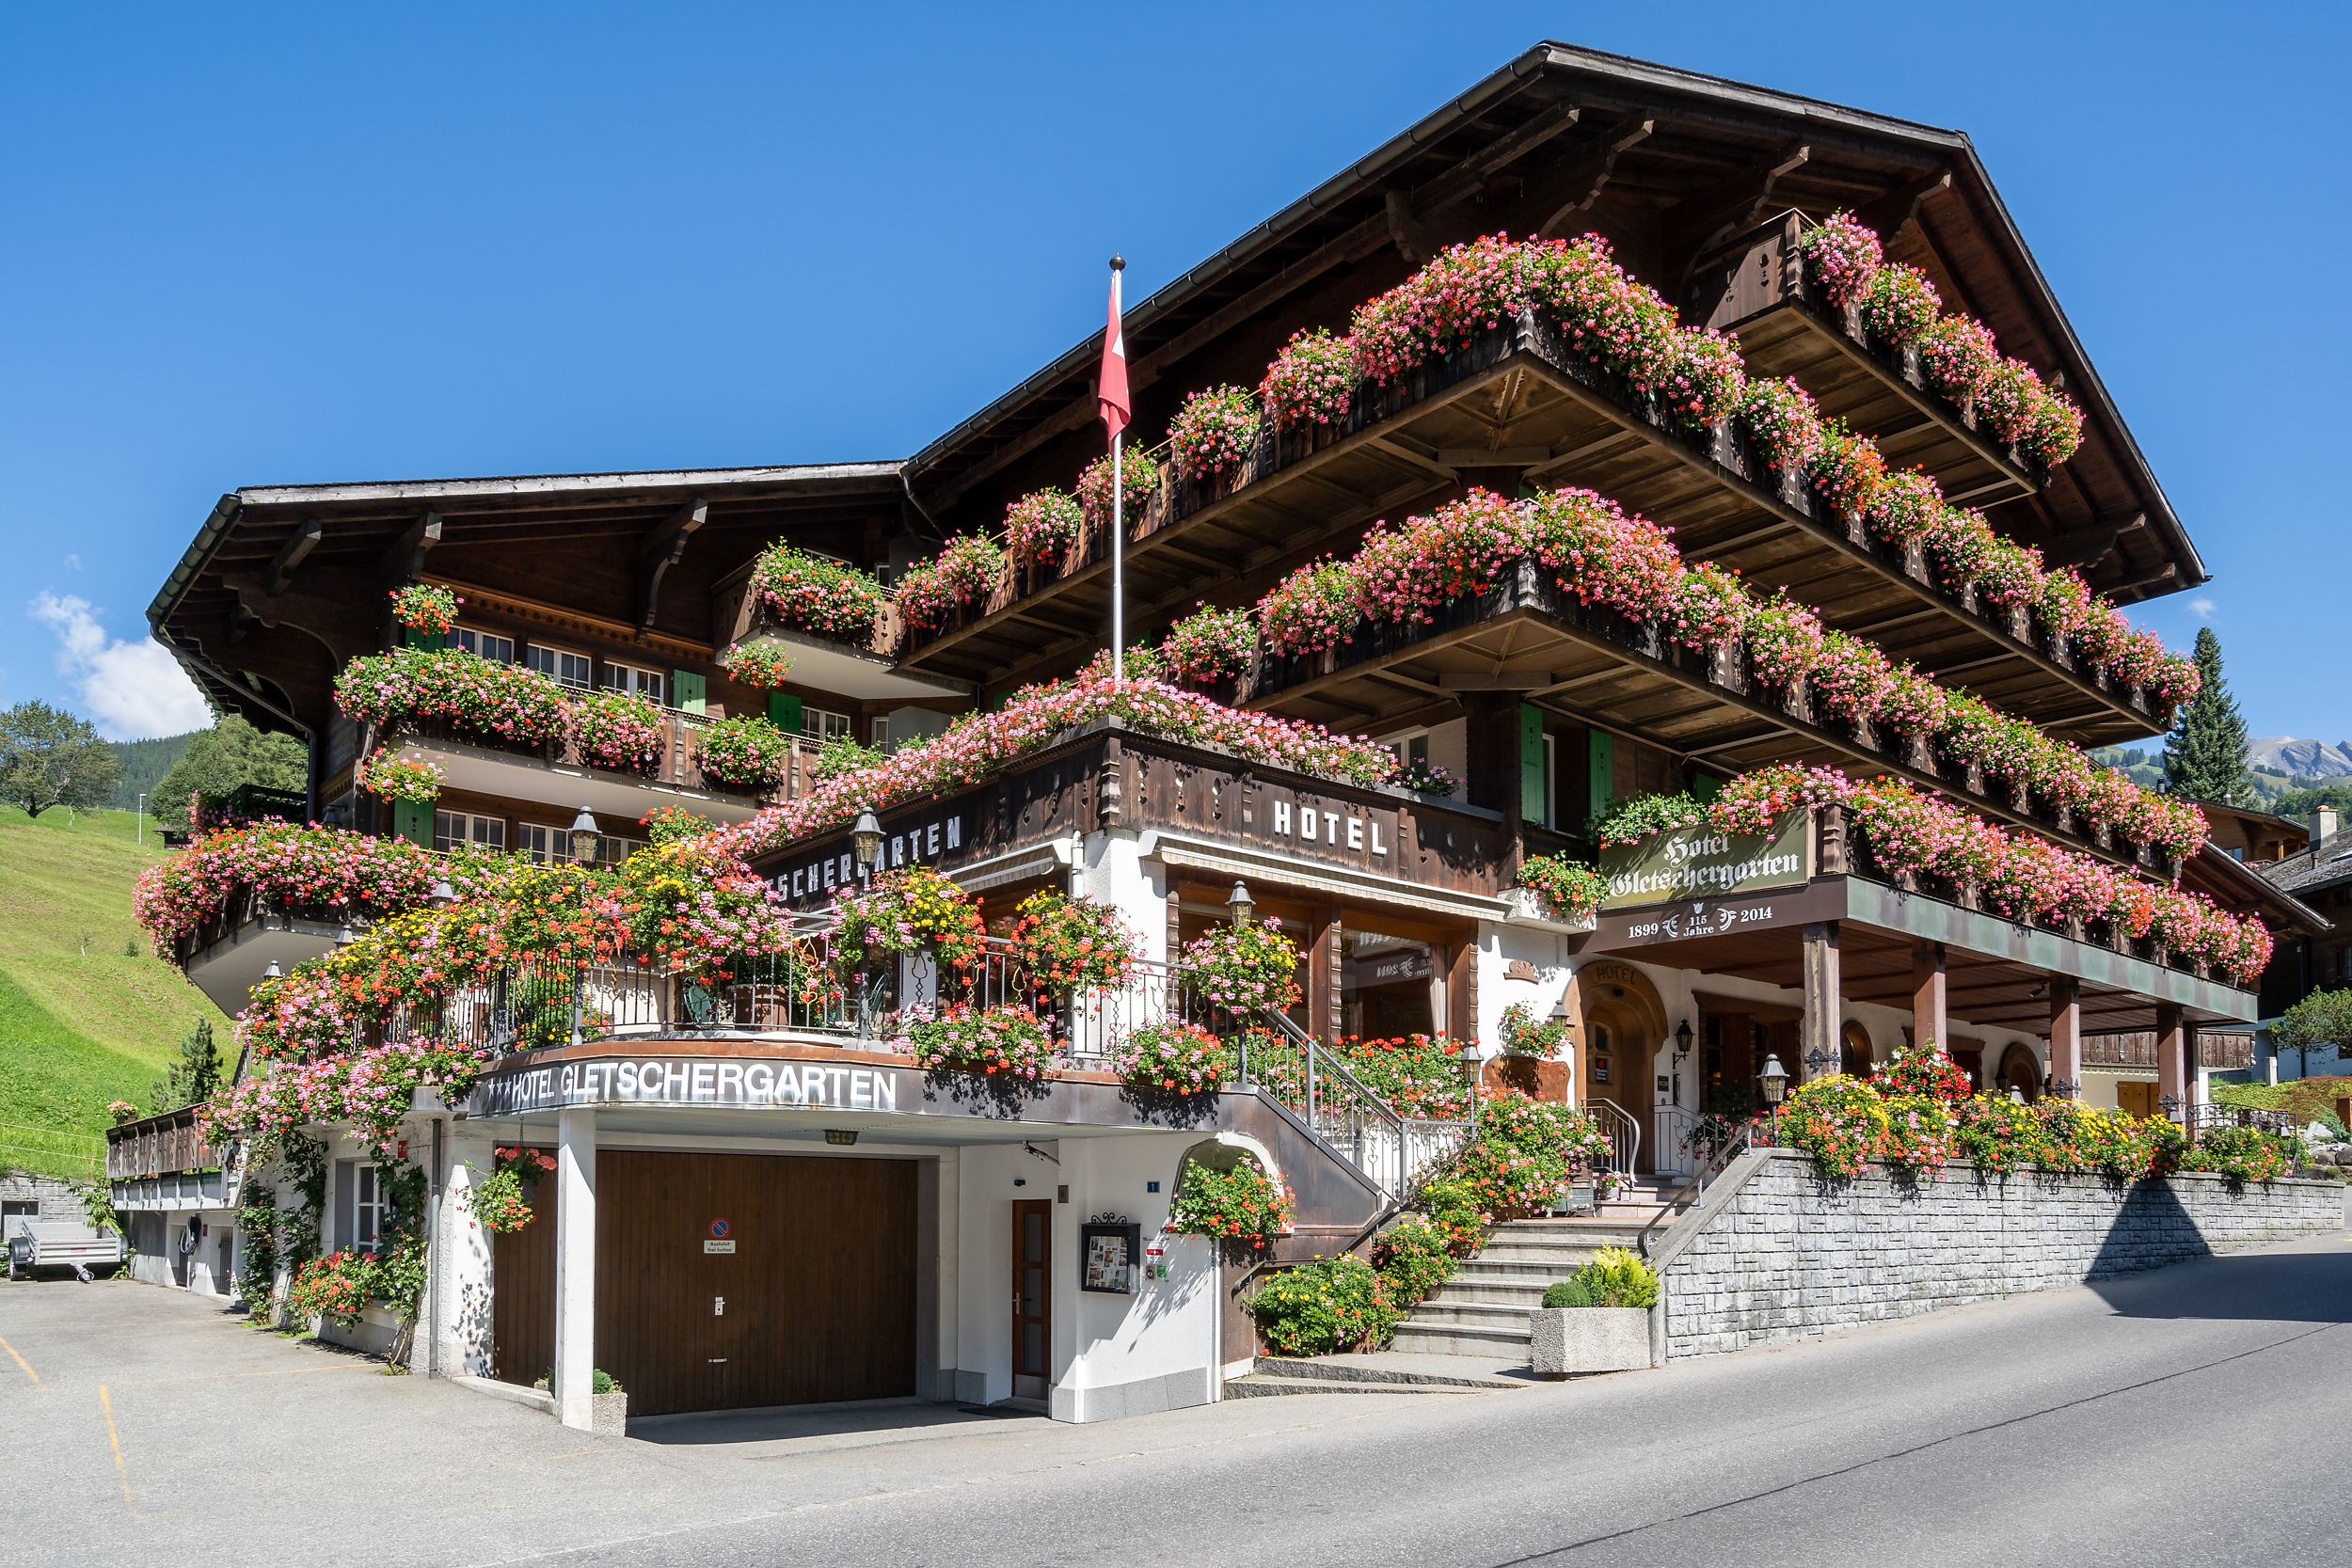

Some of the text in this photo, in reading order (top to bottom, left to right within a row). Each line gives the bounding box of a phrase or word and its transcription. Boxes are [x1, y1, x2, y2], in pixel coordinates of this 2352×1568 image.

[1274, 800, 1388, 855] HOTEL
[764, 816, 961, 906] SCHERARTEN
[1663, 832, 1731, 868] Hotel
[1609, 852, 1800, 898] Gletschergarten
[1690, 915, 1708, 927] 115
[1740, 906, 1773, 923] 2014
[1628, 923, 1659, 939] 1899
[1683, 926, 1714, 938] Jahre
[1596, 964, 1635, 985] HOTEL
[512, 1061, 897, 1103] HOTEL GLETSCHERGARTEN
